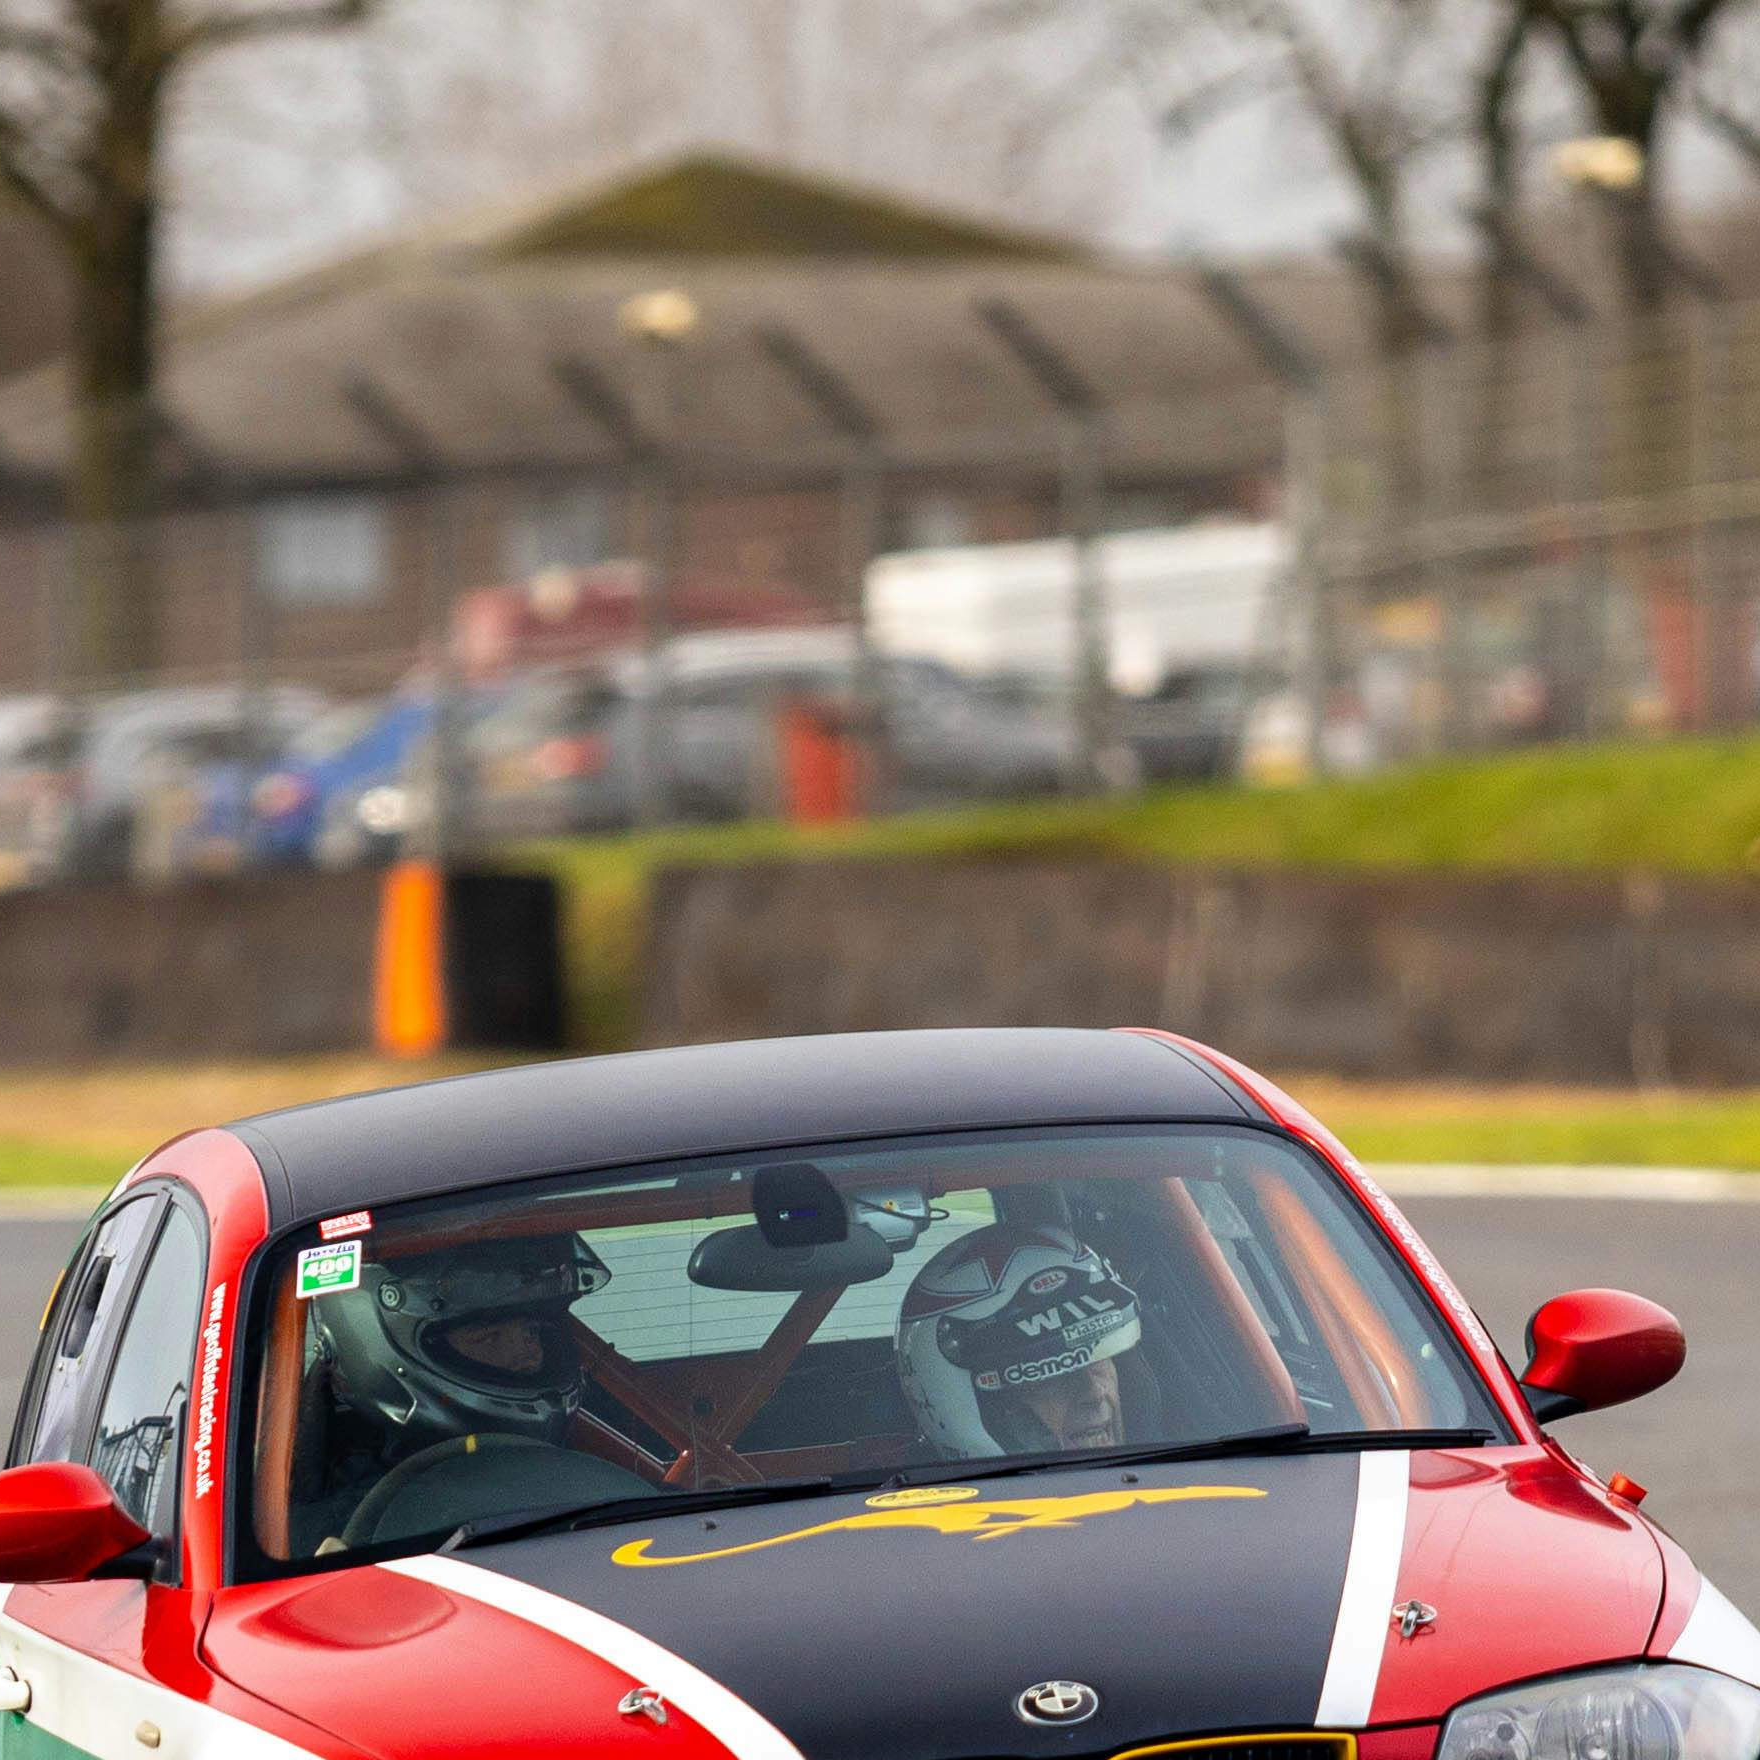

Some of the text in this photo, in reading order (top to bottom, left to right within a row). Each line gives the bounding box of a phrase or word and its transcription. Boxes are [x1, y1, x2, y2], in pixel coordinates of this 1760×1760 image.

[1032, 1273, 1065, 1289] BELL
[1016, 1294, 1115, 1337] WIL
[1005, 1347, 1091, 1383] demon
[194, 1282, 228, 1499] www.geoffsteelracing.co.uk
